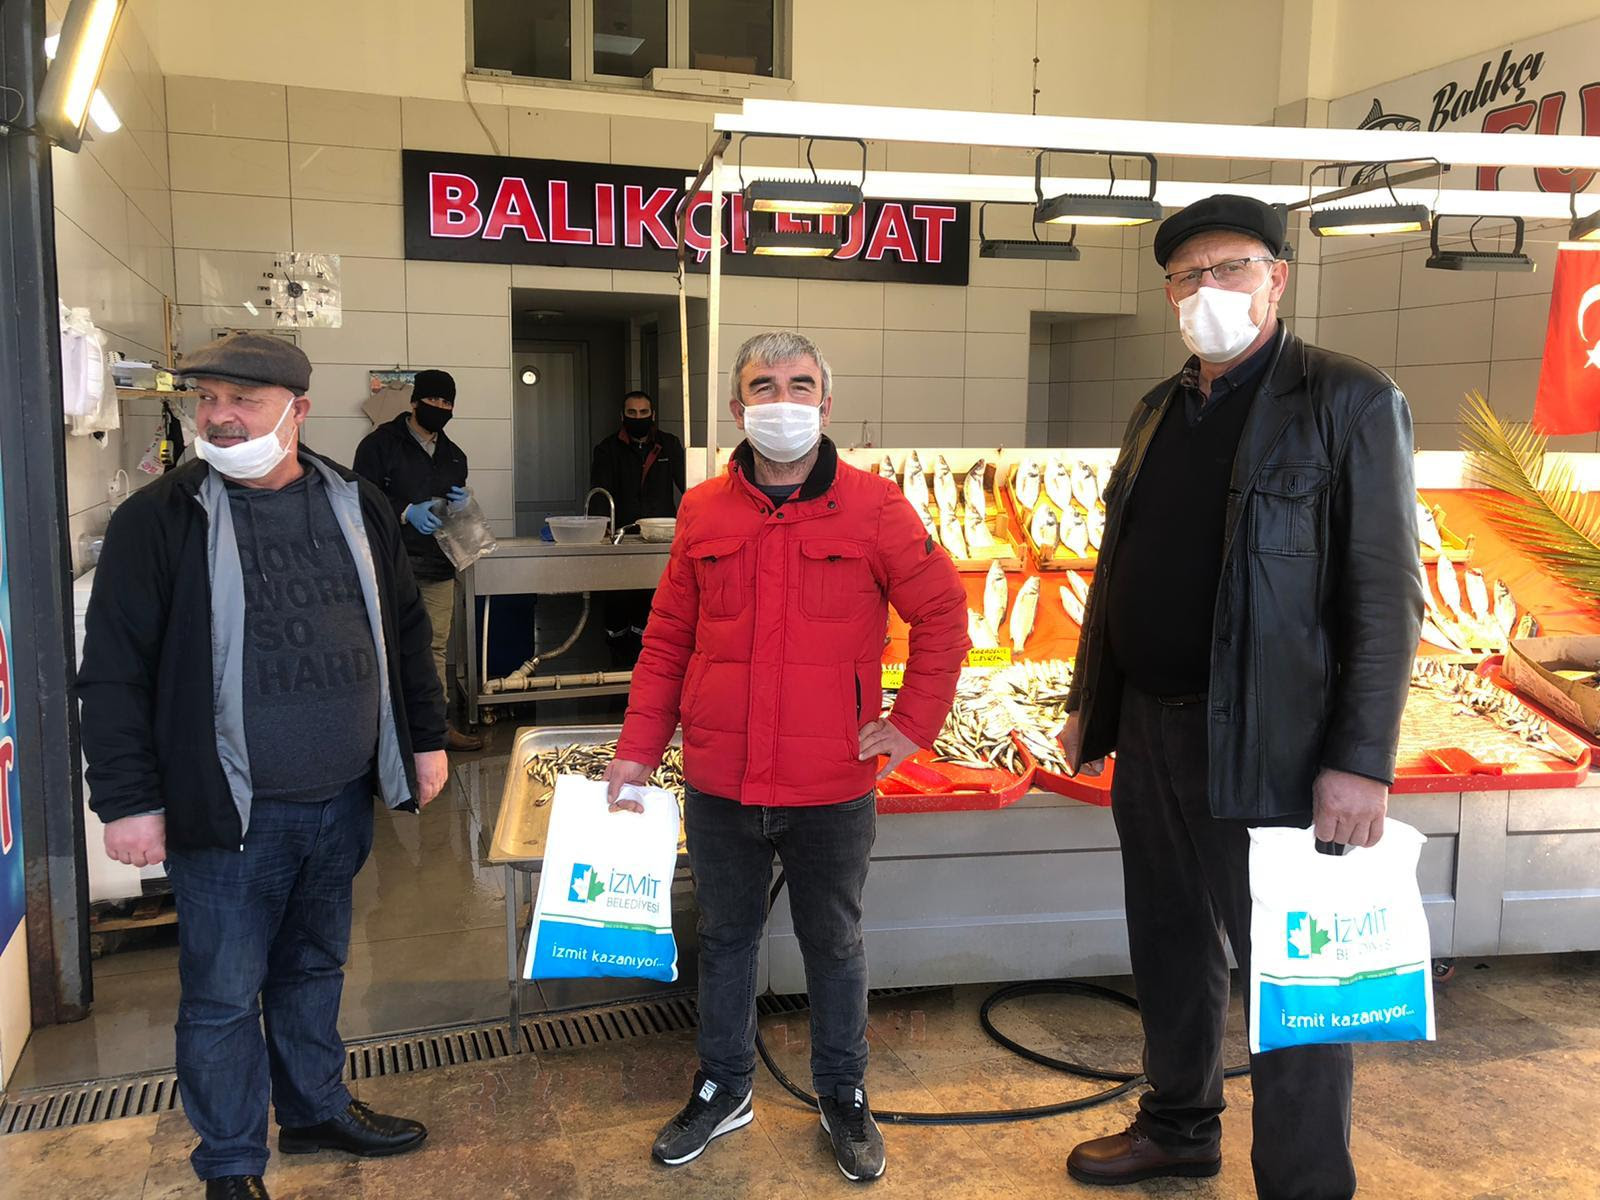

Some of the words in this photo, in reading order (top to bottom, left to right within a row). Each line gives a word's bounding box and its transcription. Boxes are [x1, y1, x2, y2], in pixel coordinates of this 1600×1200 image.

[429, 172, 747, 263] BALIKÇI
[252, 618, 314, 651] SO
[257, 650, 371, 694] HARD
[609, 868, 661, 898] İZMİT
